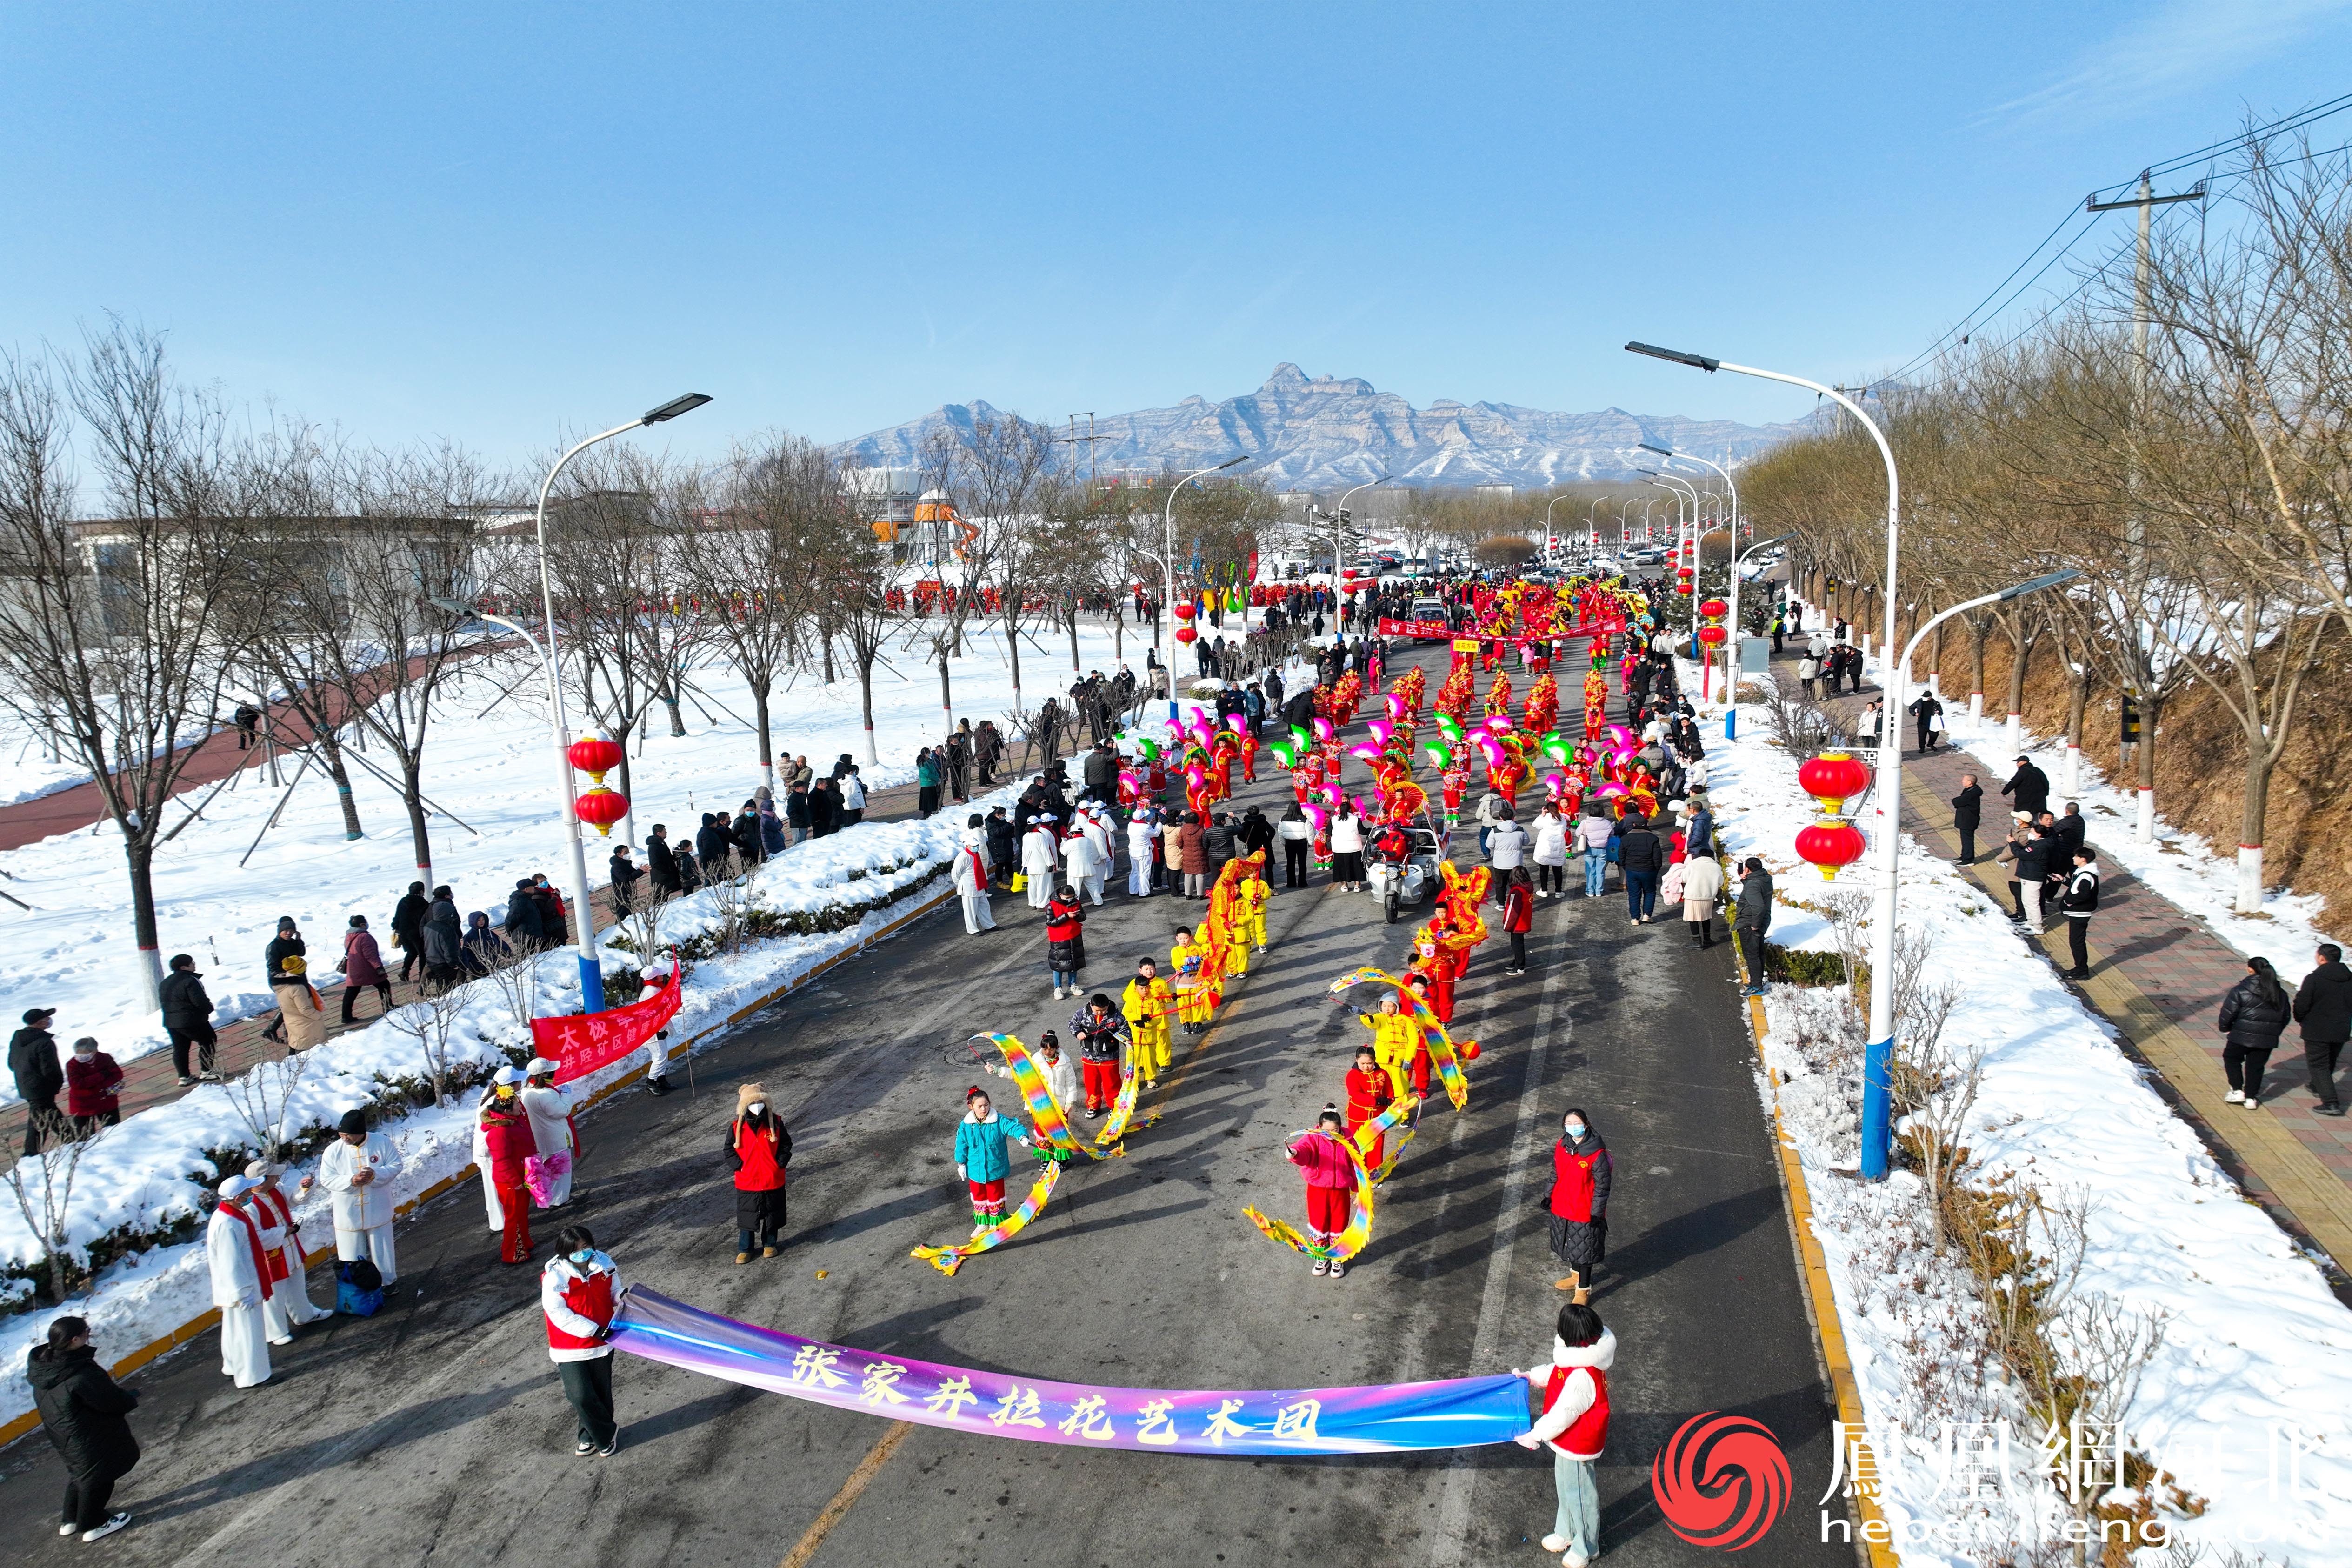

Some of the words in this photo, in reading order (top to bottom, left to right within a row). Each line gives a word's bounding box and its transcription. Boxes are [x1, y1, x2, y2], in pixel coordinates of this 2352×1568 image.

[792, 1345, 1321, 1446] 张家井拉花艺术团
